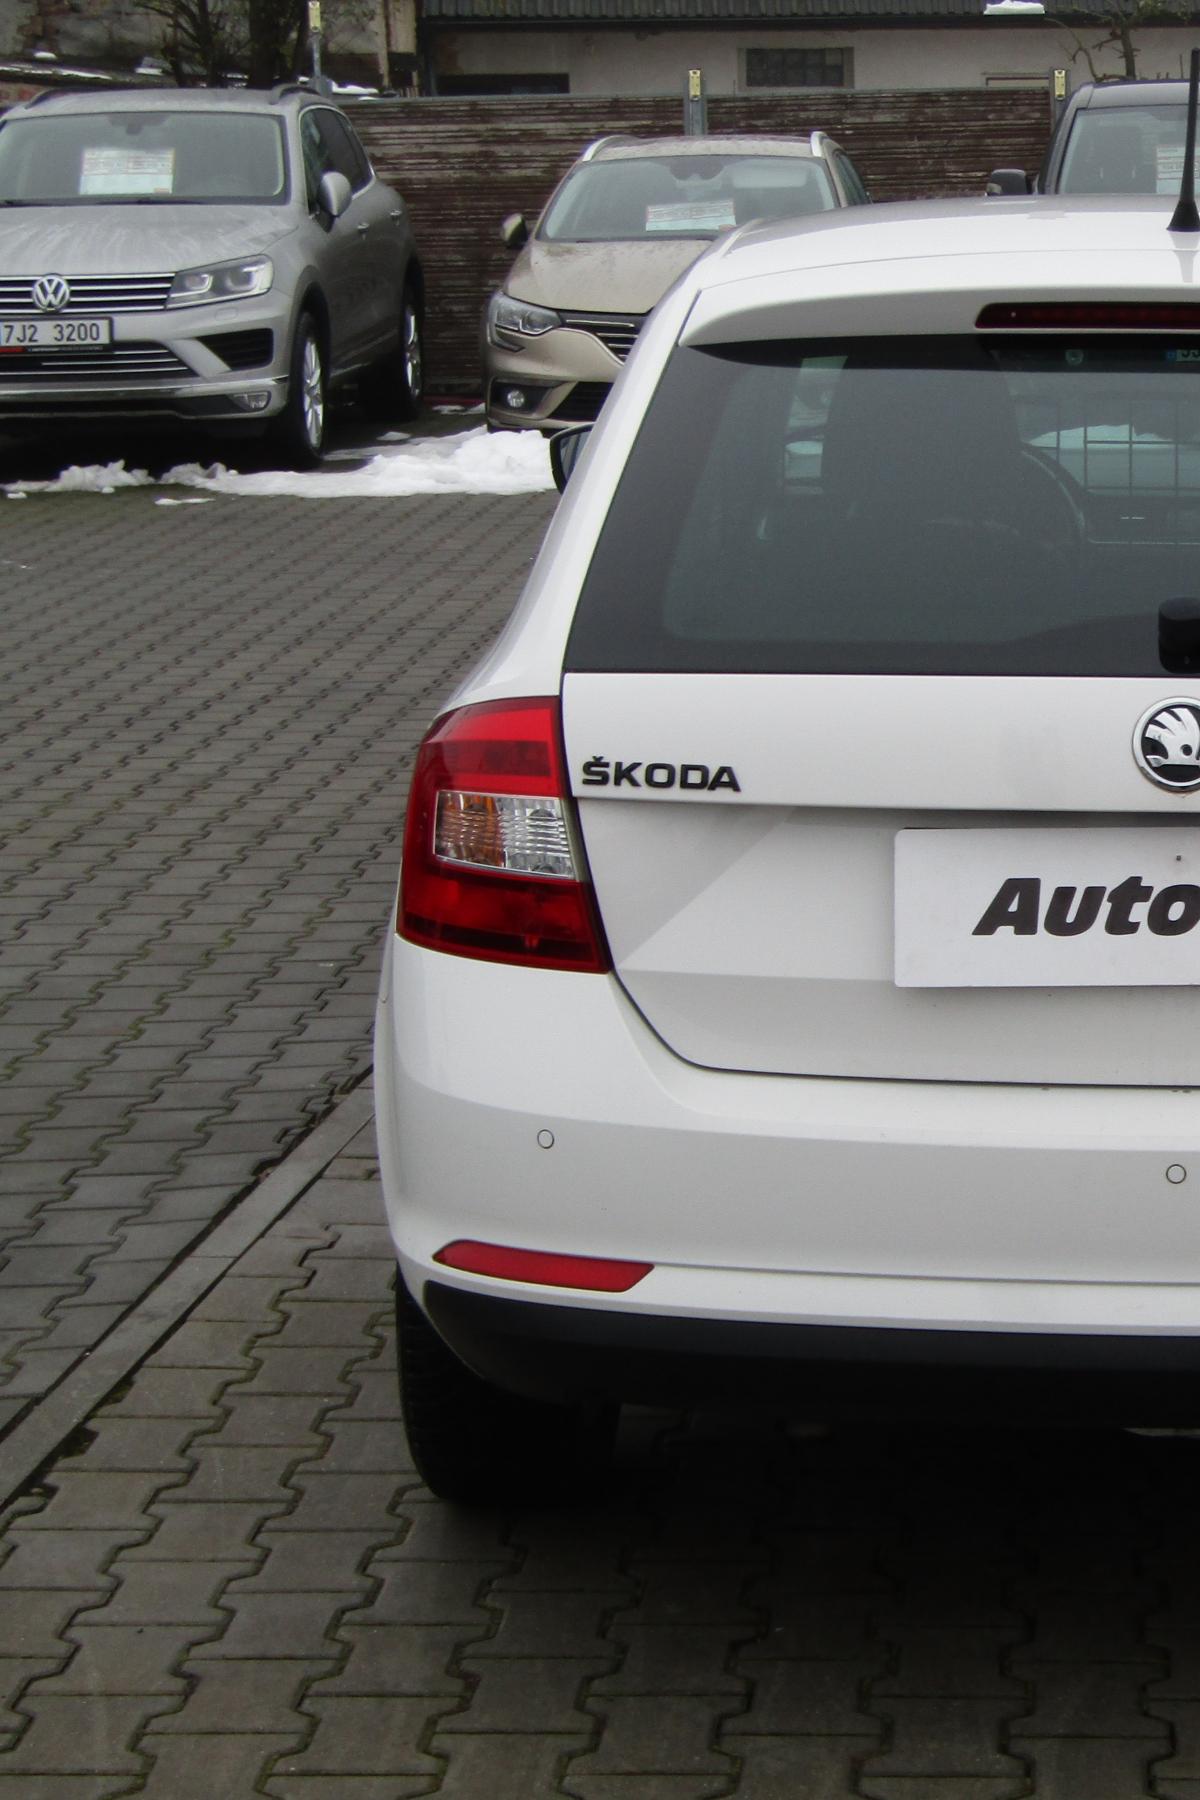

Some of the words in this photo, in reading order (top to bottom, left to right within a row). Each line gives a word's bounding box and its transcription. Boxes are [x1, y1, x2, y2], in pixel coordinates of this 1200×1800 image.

[4, 324, 39, 344] 7J2
[54, 322, 100, 342] 3200
[582, 755, 742, 793] ŠKODA
